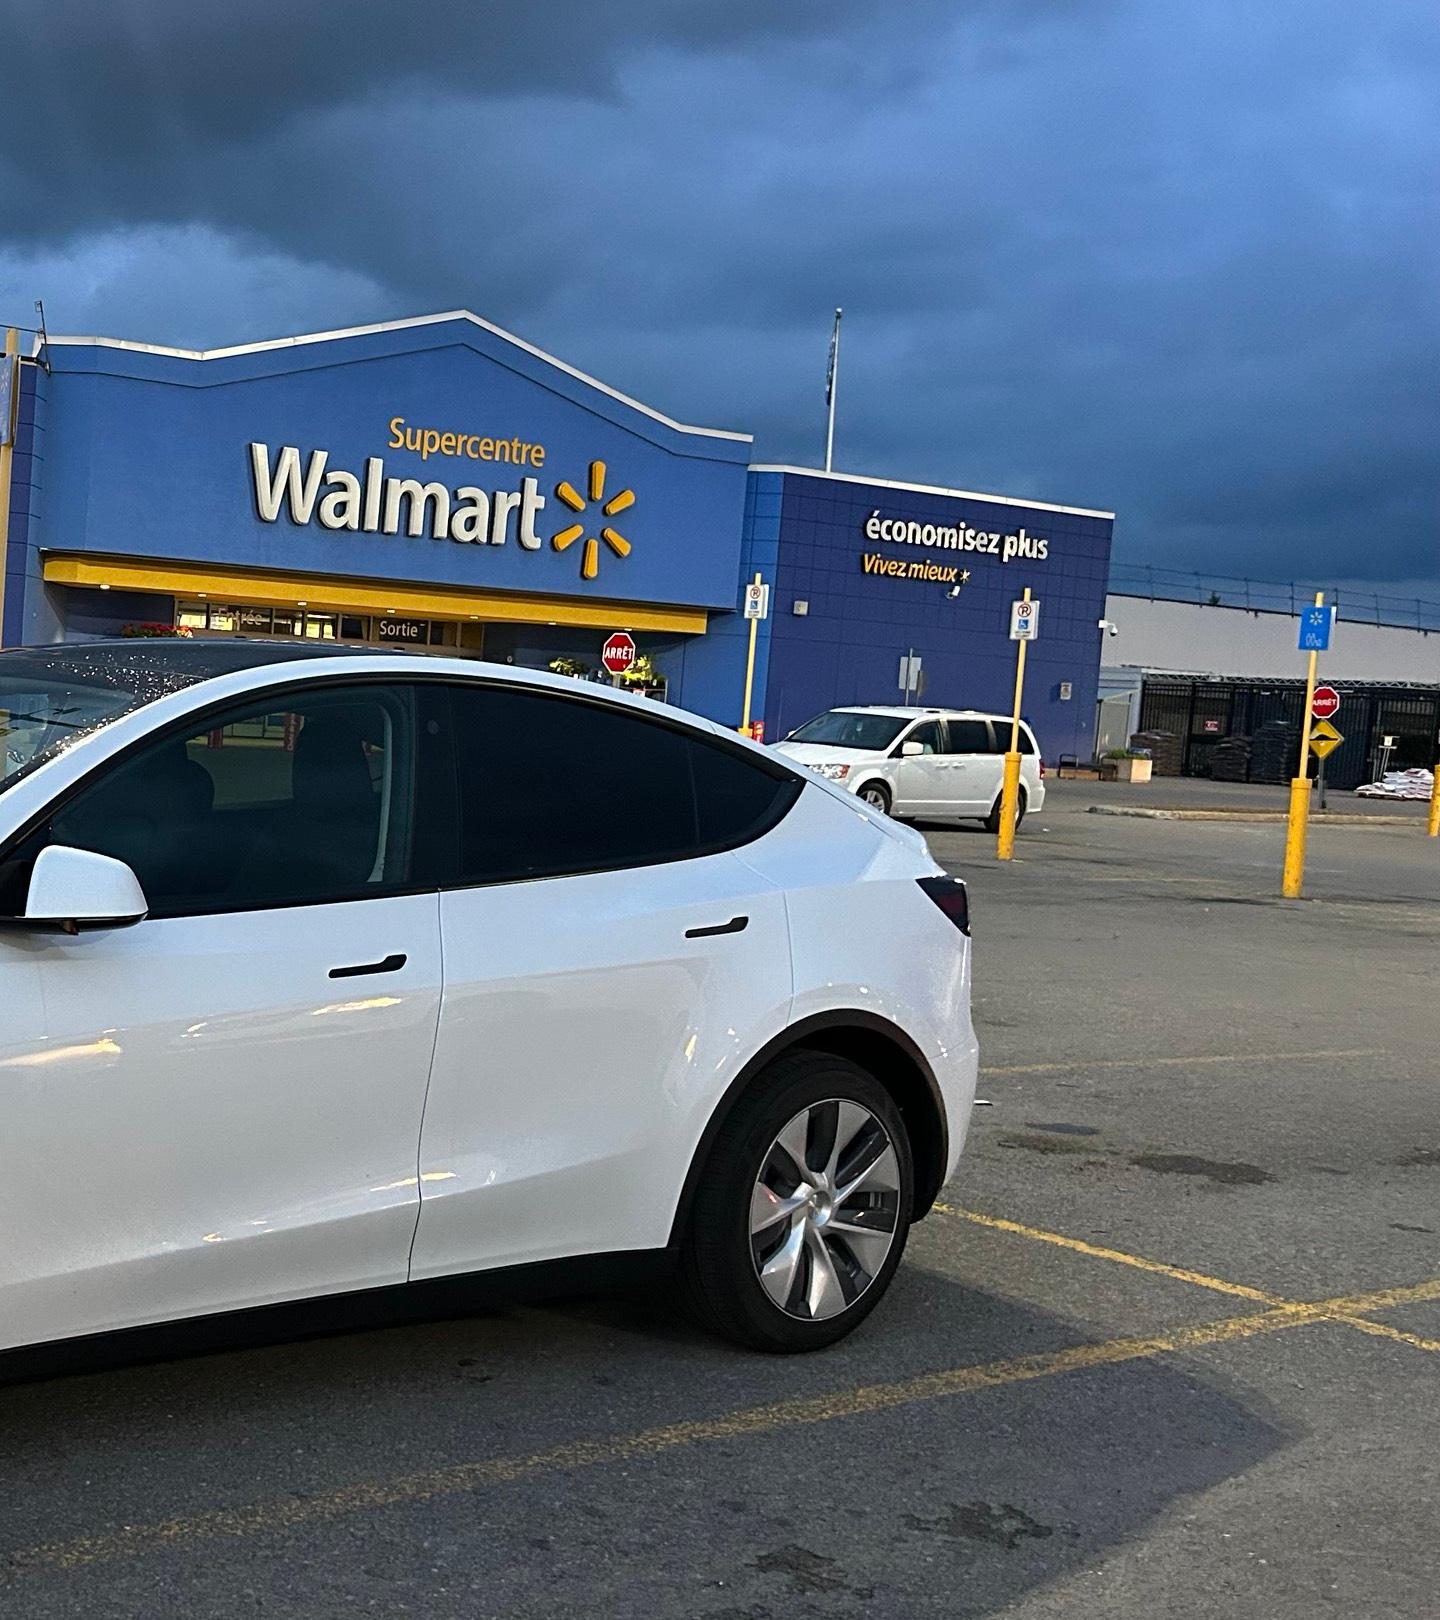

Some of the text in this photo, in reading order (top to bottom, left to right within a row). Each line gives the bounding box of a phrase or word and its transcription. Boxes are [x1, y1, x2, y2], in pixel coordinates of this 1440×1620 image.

[388, 416, 546, 469] Supercentre
[250, 441, 546, 551] Walmart
[865, 509, 1049, 563] économisez plus
[863, 552, 958, 583] Vivez mieux
[218, 606, 262, 626] Entrée
[379, 620, 418, 637] Sortie
[604, 645, 633, 660] ARRÊT
